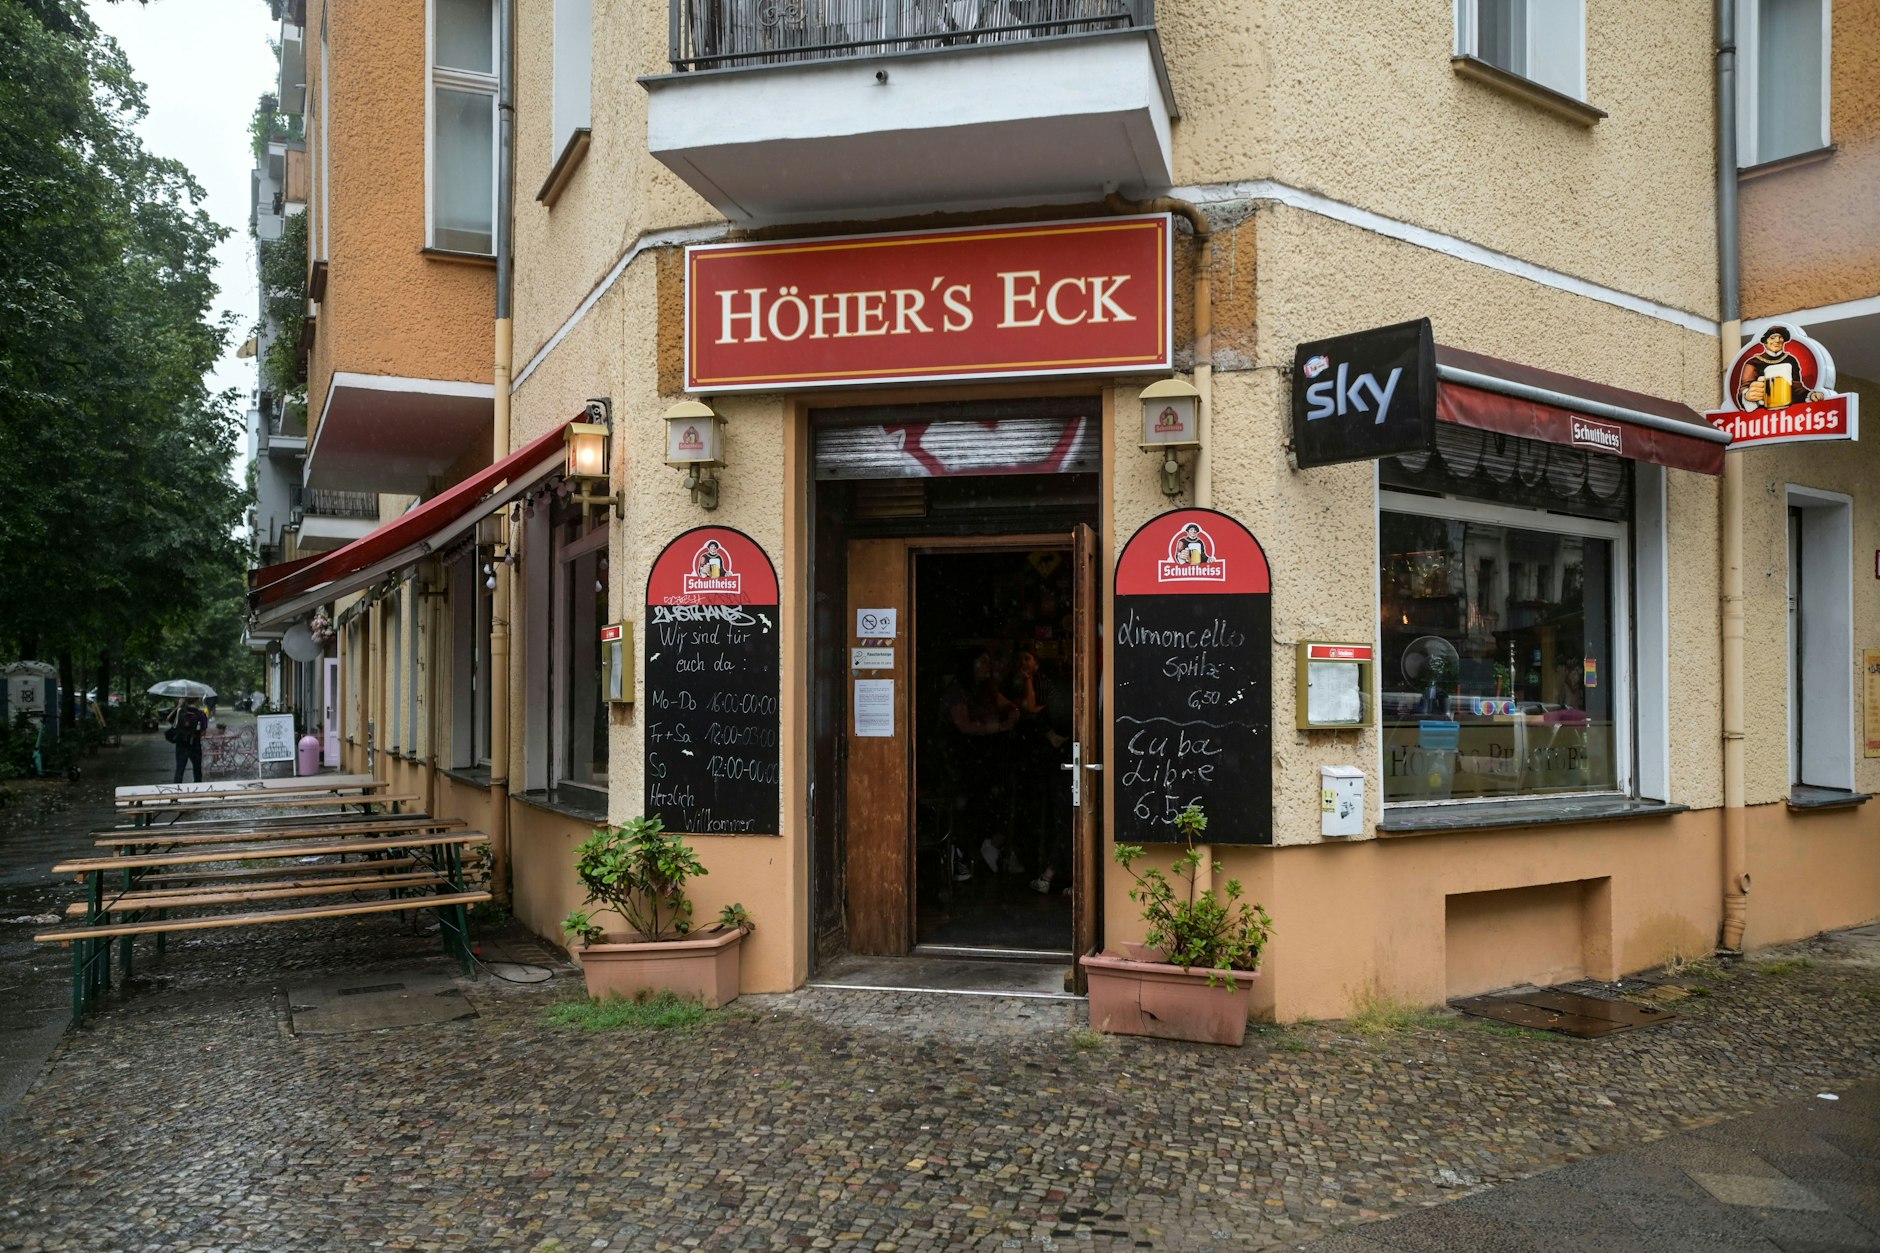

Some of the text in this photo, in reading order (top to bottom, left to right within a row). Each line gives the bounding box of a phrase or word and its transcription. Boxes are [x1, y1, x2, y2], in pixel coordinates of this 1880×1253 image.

[1306, 362, 1403, 425] sky
[1573, 422, 1620, 448] Schultheiss
[688, 578, 737, 589] Schultheiss
[1163, 565, 1221, 577] Schultheiss
[659, 621, 688, 653] Wir
[690, 623, 720, 645] sind
[675, 652, 706, 673] euch
[1187, 689, 1221, 710] 6,50
[649, 751, 667, 779] So
[649, 782, 695, 808] Herzlich
